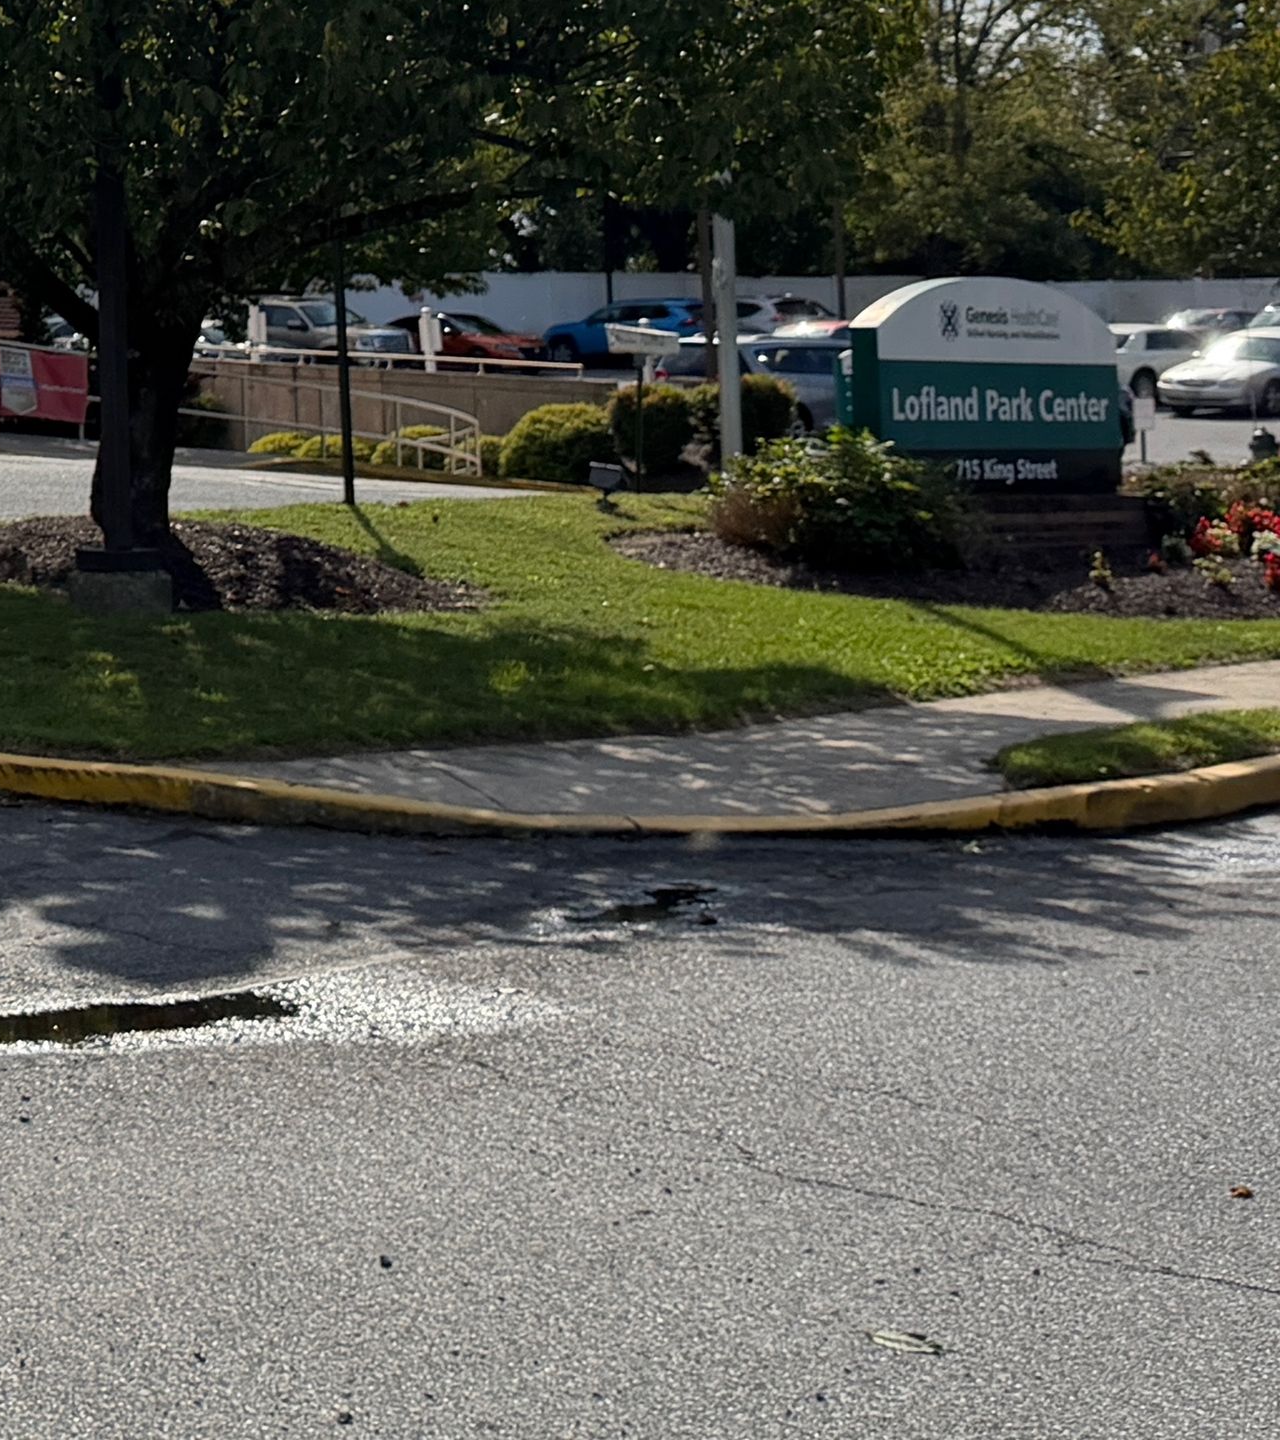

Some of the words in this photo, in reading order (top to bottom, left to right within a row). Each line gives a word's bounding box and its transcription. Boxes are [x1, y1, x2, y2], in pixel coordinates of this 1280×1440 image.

[965, 306, 1009, 326] Genesis
[892, 385, 979, 422] Lofland
[985, 387, 1033, 422] Park
[1039, 389, 1109, 423] Center
[956, 458, 981, 481] 715
[982, 457, 1016, 486] King
[1017, 458, 1058, 481] Street
